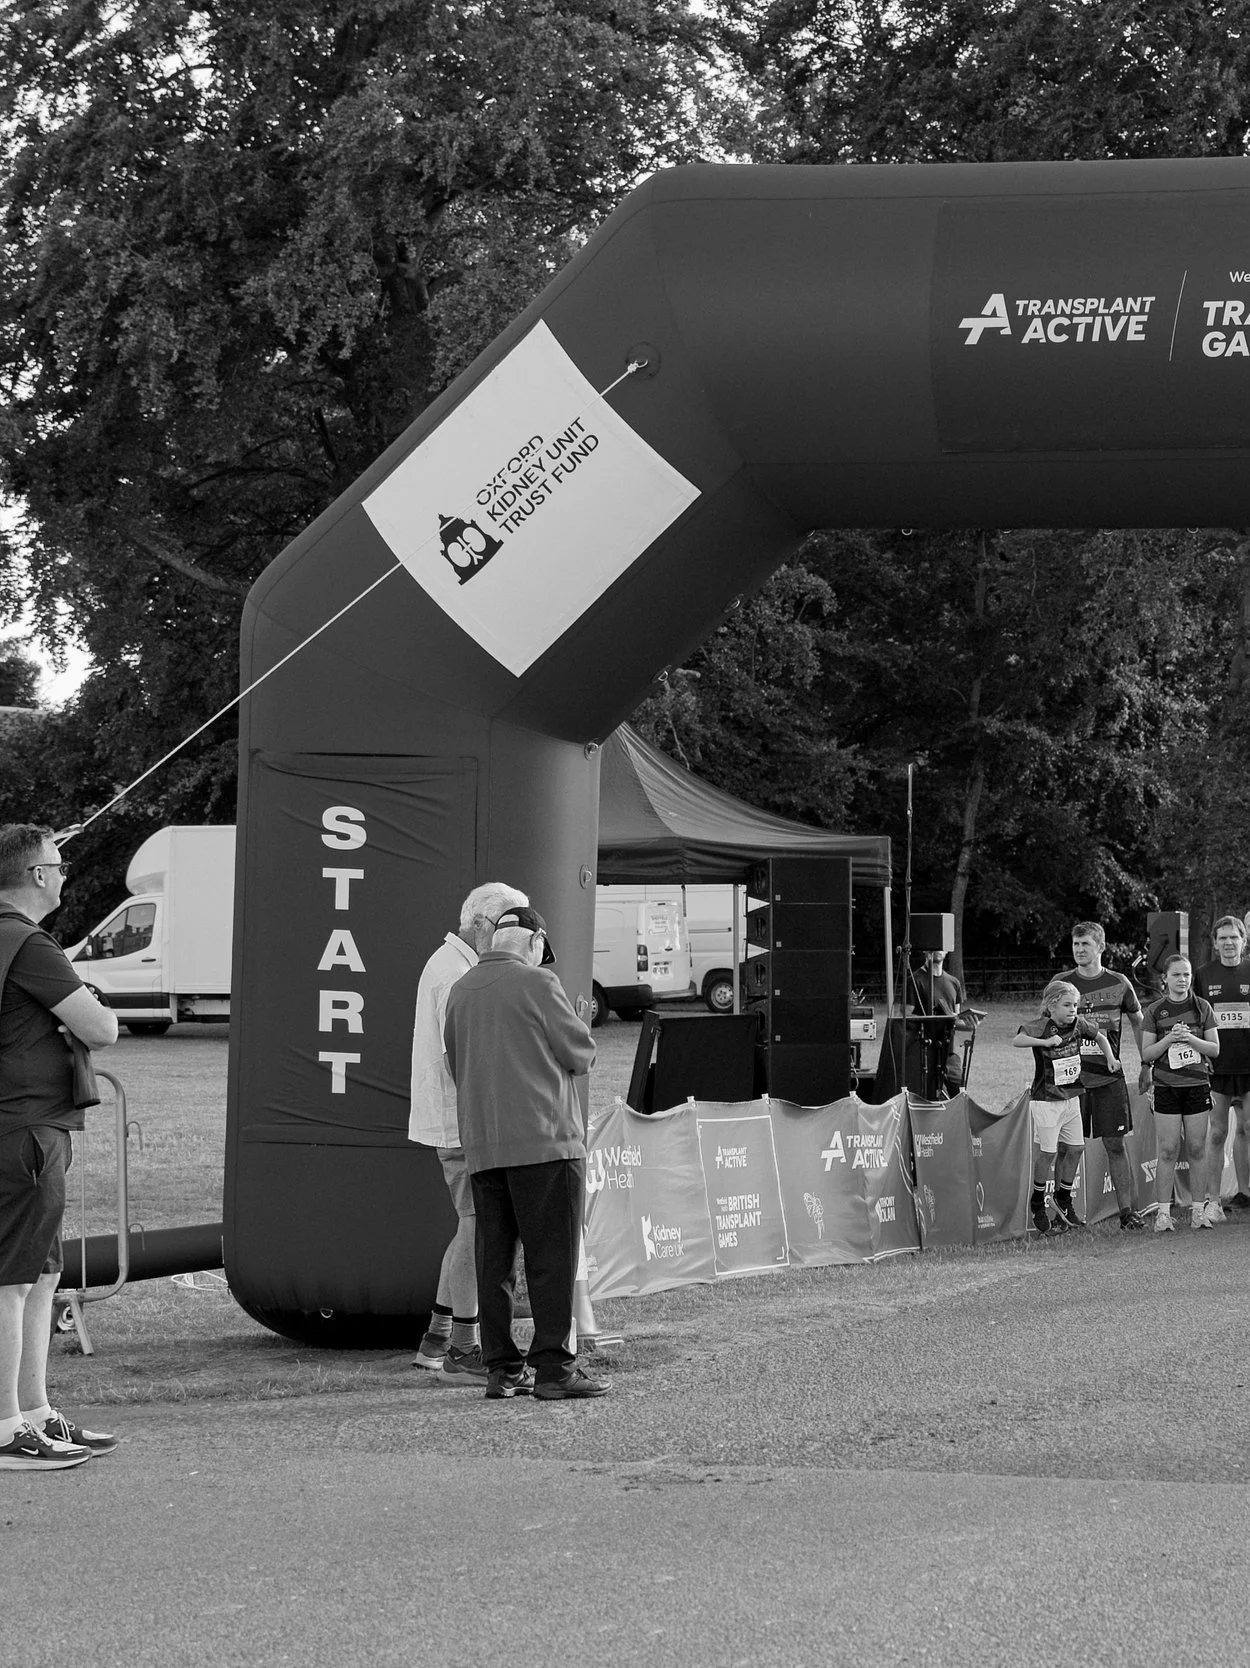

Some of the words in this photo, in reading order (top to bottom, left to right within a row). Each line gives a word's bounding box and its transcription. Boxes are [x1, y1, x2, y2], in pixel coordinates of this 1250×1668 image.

[1015, 296, 1156, 316] TRANSPLANT
[1021, 315, 1149, 344] ACTIVE
[476, 435, 544, 505] OXFORD
[486, 457, 547, 522] KIDNEY
[545, 416, 585, 460] UNIT
[499, 479, 553, 534] TRUST
[551, 434, 599, 484] FUND
[317, 805, 367, 1094] START
[1220, 1012, 1243, 1021] 6135
[1178, 1049, 1194, 1060] 162
[1064, 1066, 1078, 1077] 169
[725, 1155, 748, 1168] ACTIVE
[728, 1193, 760, 1211] BRITISH
[716, 1211, 762, 1231] TRANSPLANT
[653, 1224, 681, 1243] Kidney
[717, 1231, 738, 1248] GAMES
[656, 1243, 674, 1259] Care
